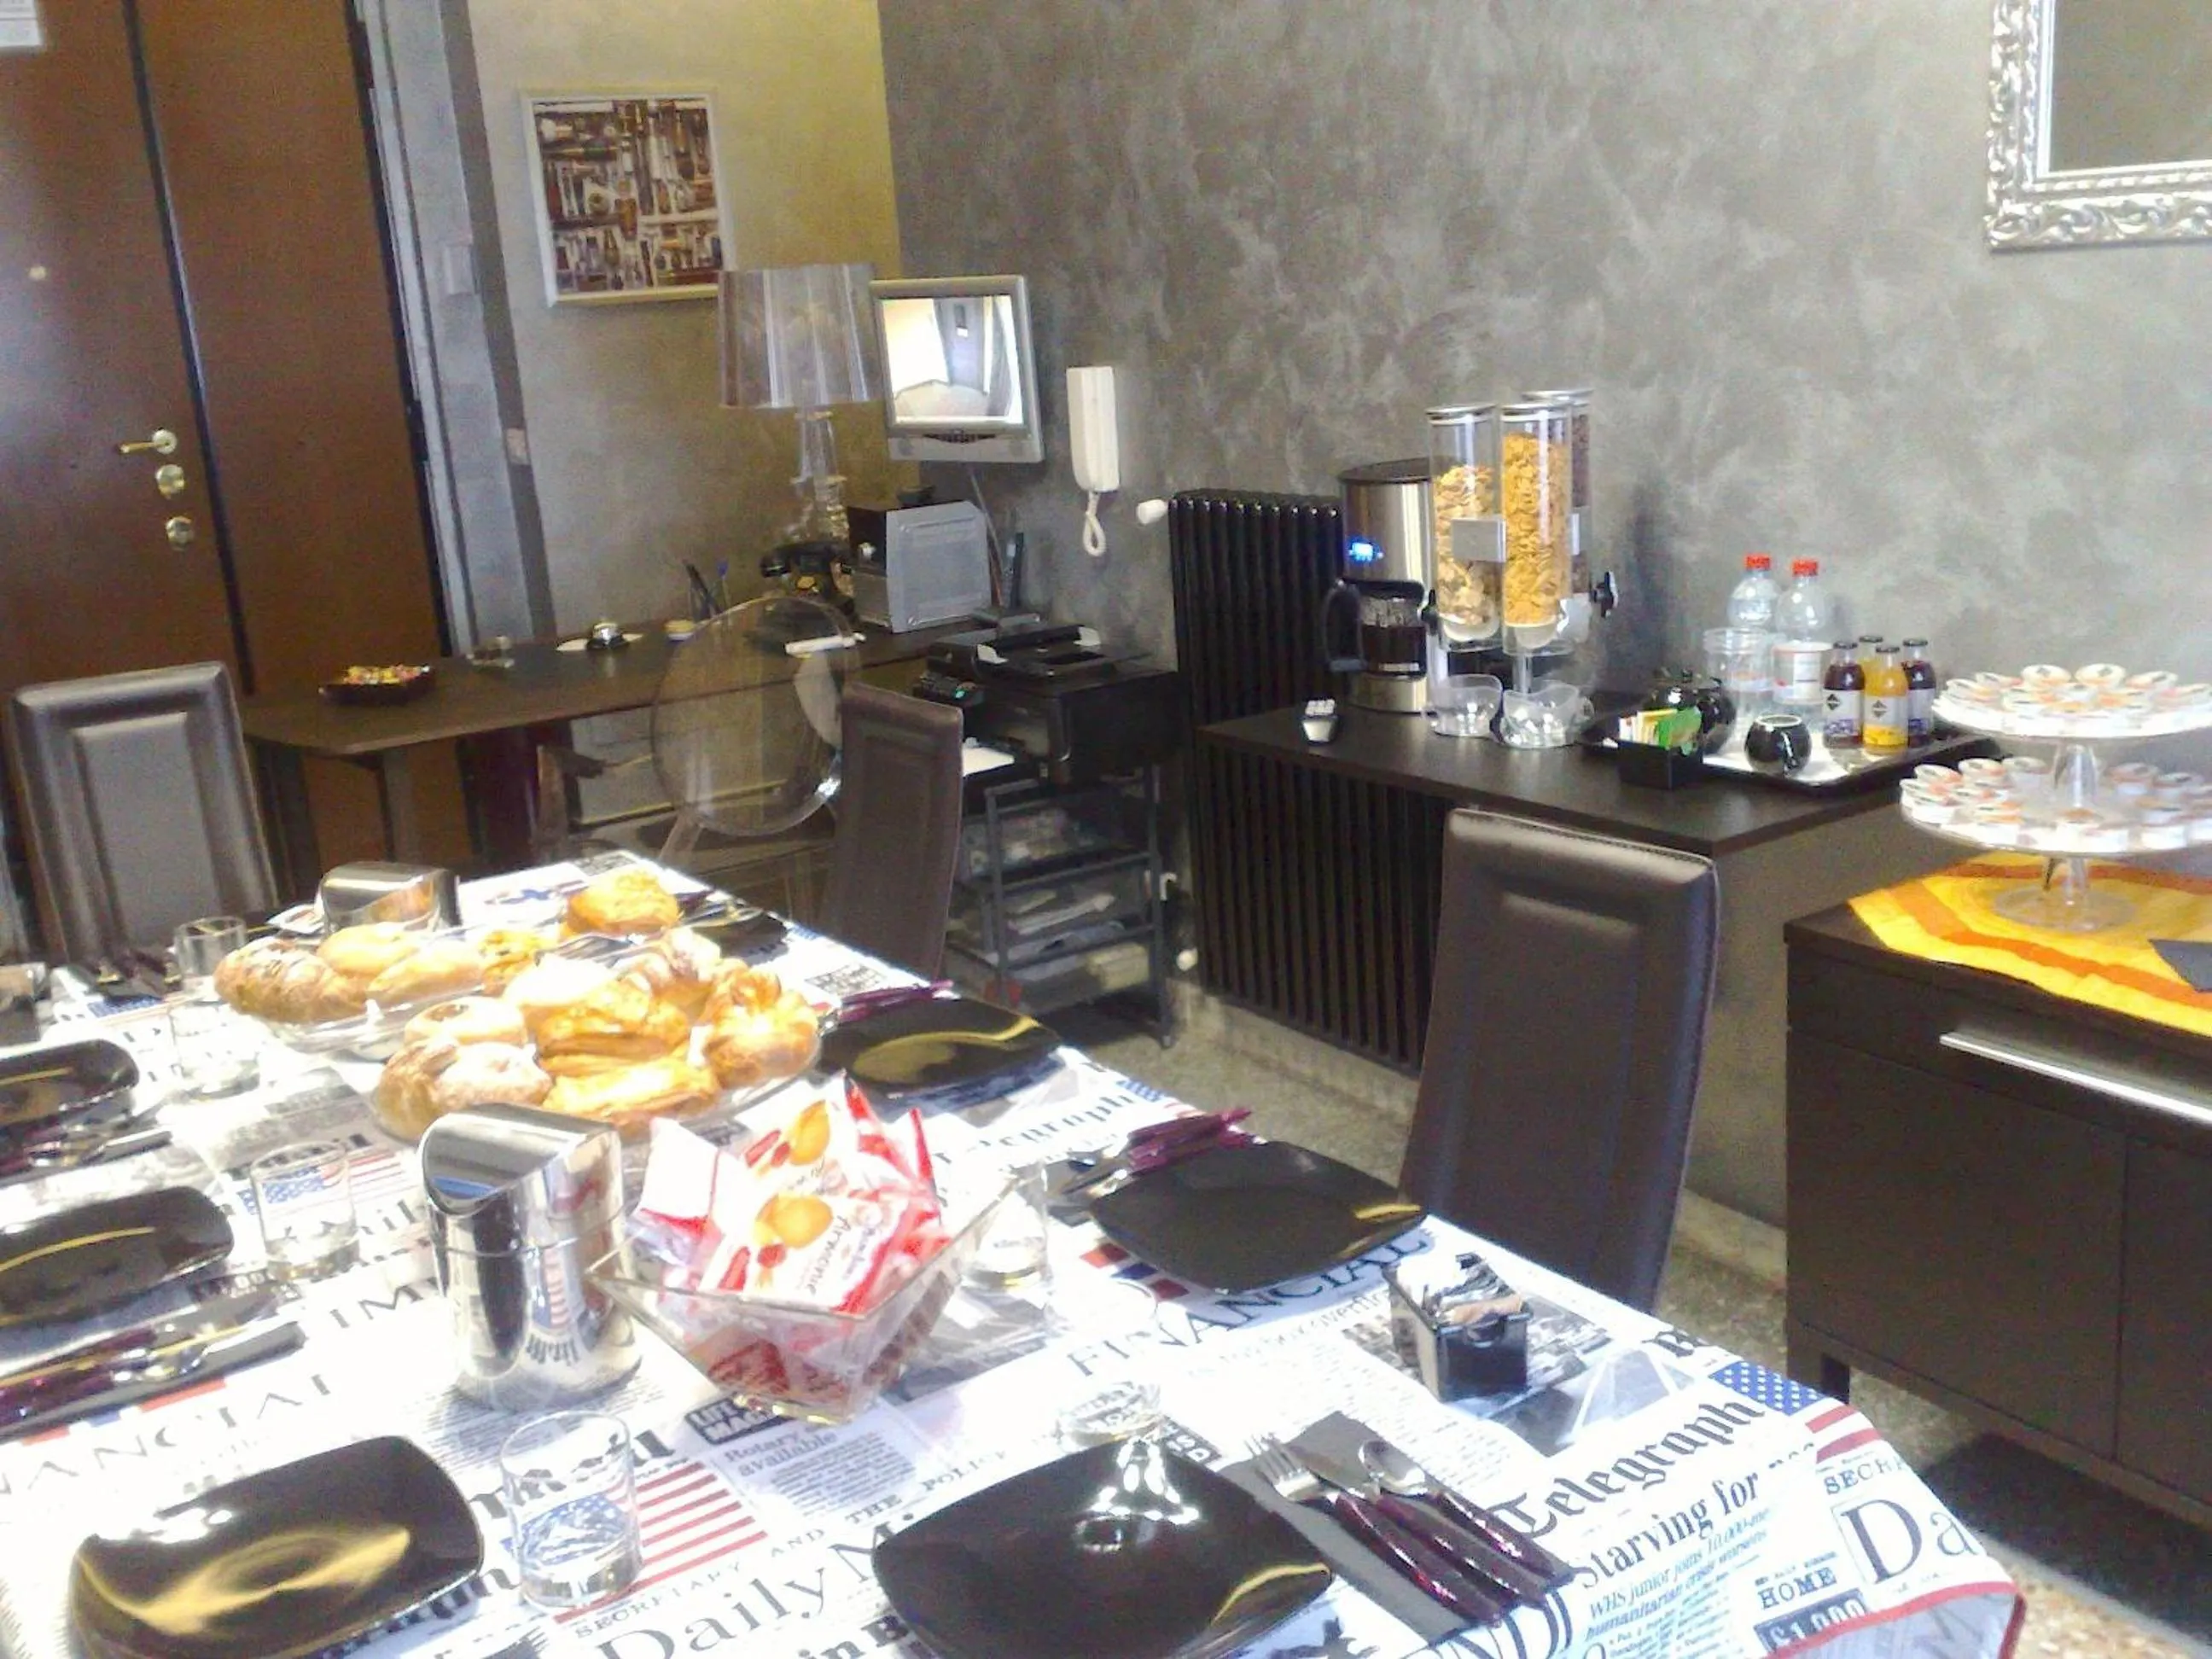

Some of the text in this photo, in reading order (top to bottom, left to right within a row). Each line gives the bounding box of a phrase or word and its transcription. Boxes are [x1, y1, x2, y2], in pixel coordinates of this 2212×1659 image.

[737, 1431, 838, 1477] available
[1487, 1400, 1765, 1539] Telegraph
[1711, 1470, 1760, 1516] for
[770, 1527, 826, 1558] AND
[844, 1493, 903, 1525] THE
[594, 1567, 825, 1659] Daily
[1756, 1566, 1837, 1610] HOME
